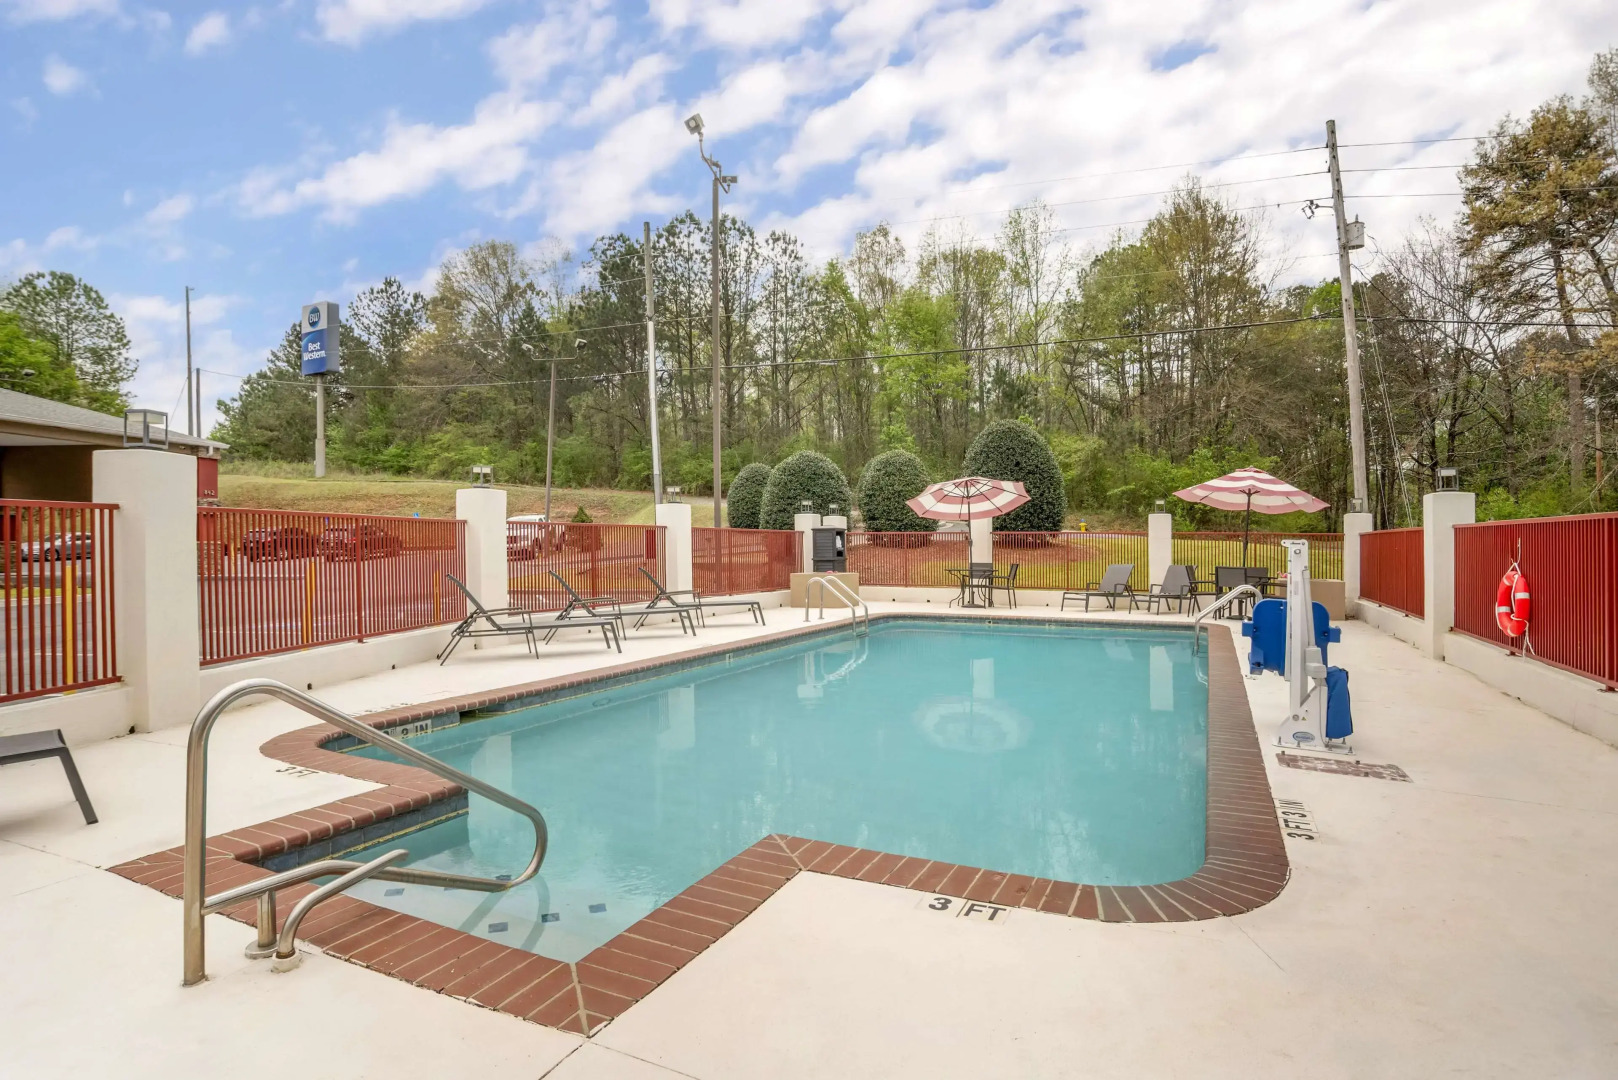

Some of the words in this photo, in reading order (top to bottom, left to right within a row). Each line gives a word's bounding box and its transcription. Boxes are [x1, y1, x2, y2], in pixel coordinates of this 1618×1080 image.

[308, 341, 321, 352] Best
[303, 350, 326, 361] Western
[1278, 799, 1305, 810] IN
[1281, 810, 1307, 818] 3
[1283, 818, 1313, 832] FT
[1287, 832, 1315, 841] 3
[928, 896, 953, 911] 3
[963, 902, 1007, 921] FT
